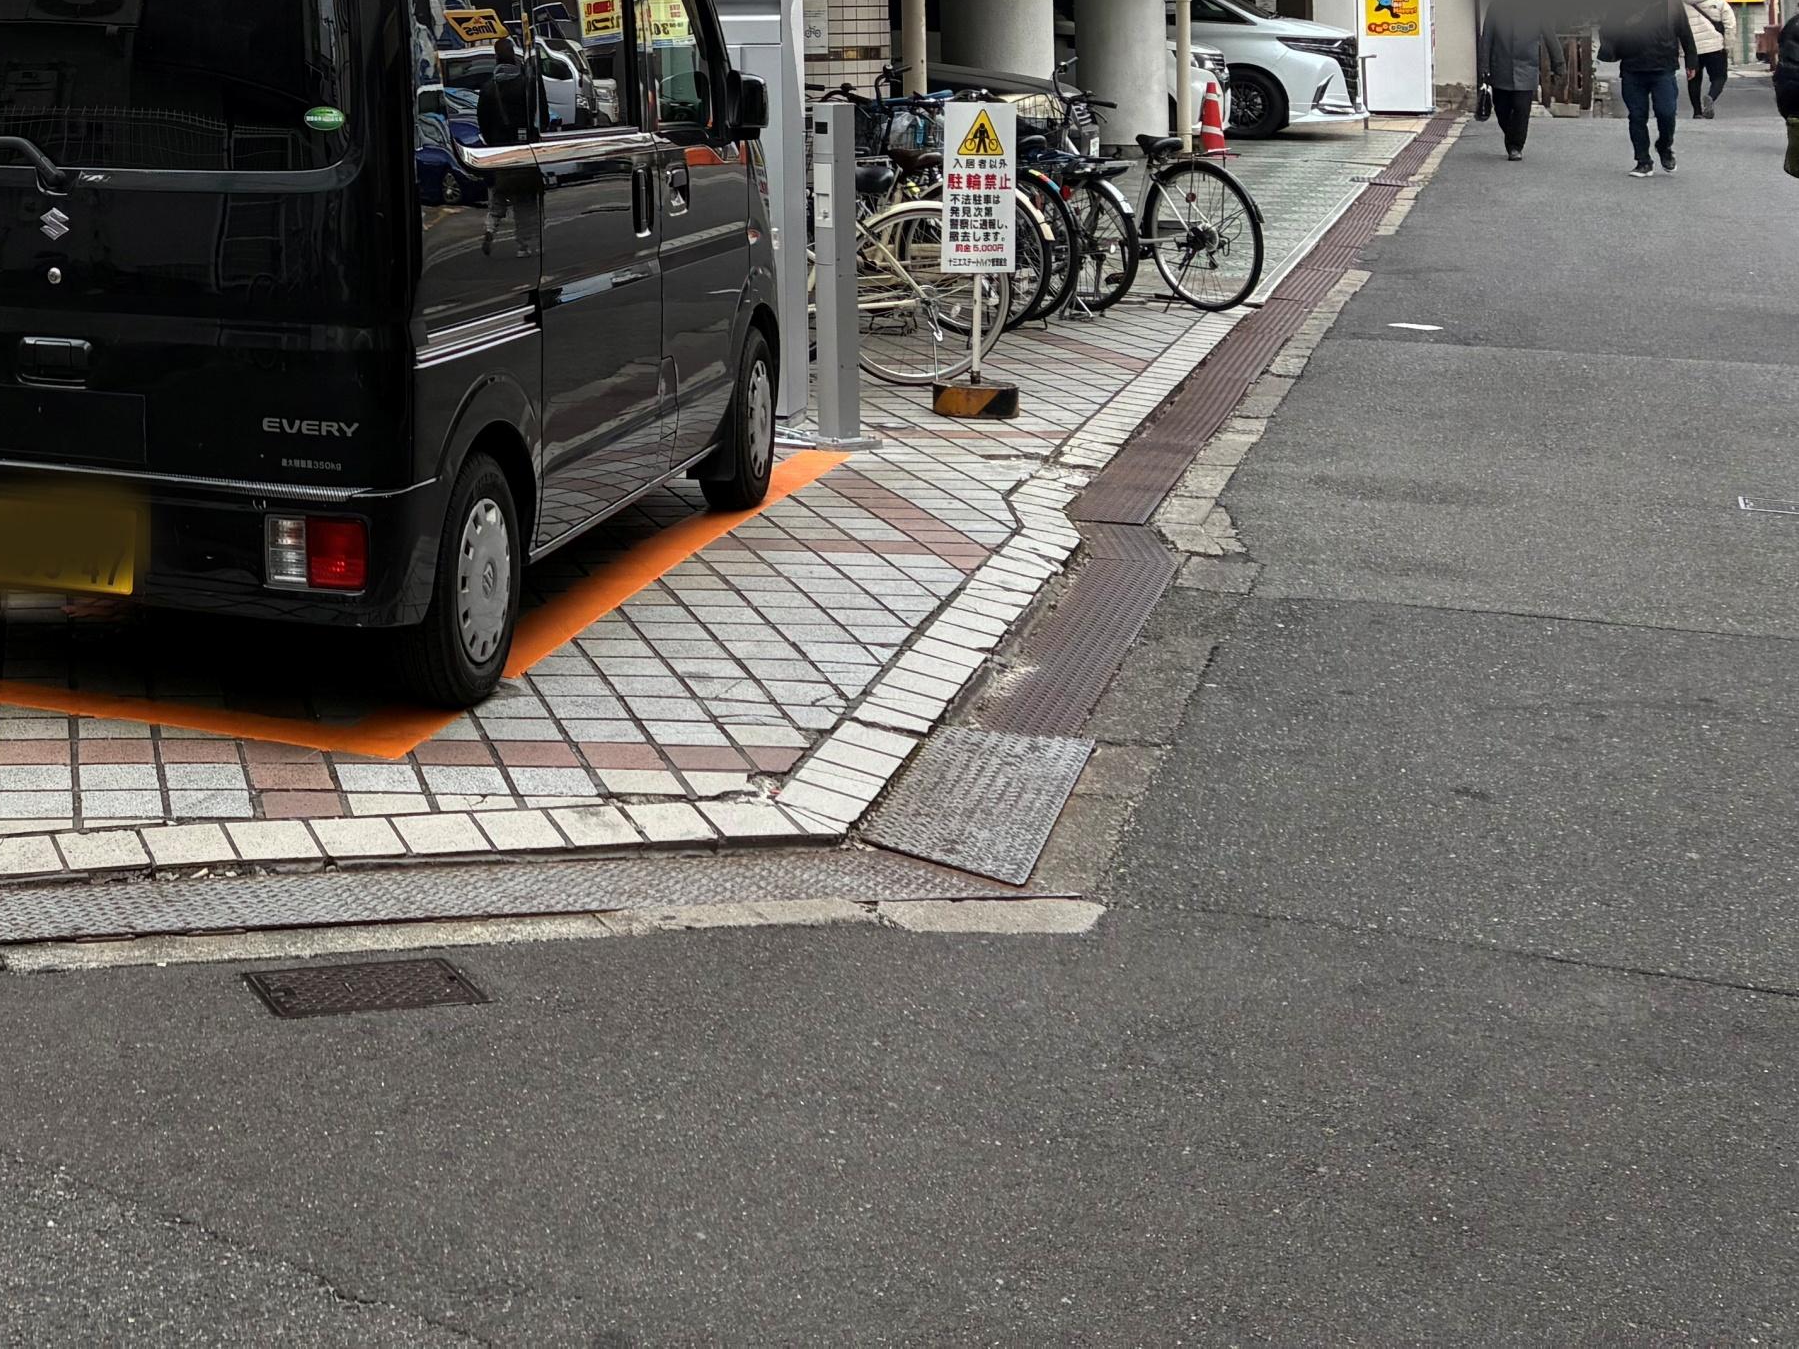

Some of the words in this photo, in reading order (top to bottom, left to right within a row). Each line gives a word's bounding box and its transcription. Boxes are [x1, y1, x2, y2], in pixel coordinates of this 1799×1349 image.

[952, 158, 1008, 170] 入居者以外
[947, 173, 1012, 190] 駐輪禁止
[949, 193, 1001, 205] 不法駐車は
[949, 206, 993, 217] 発見次第
[262, 417, 360, 437] EVERY
